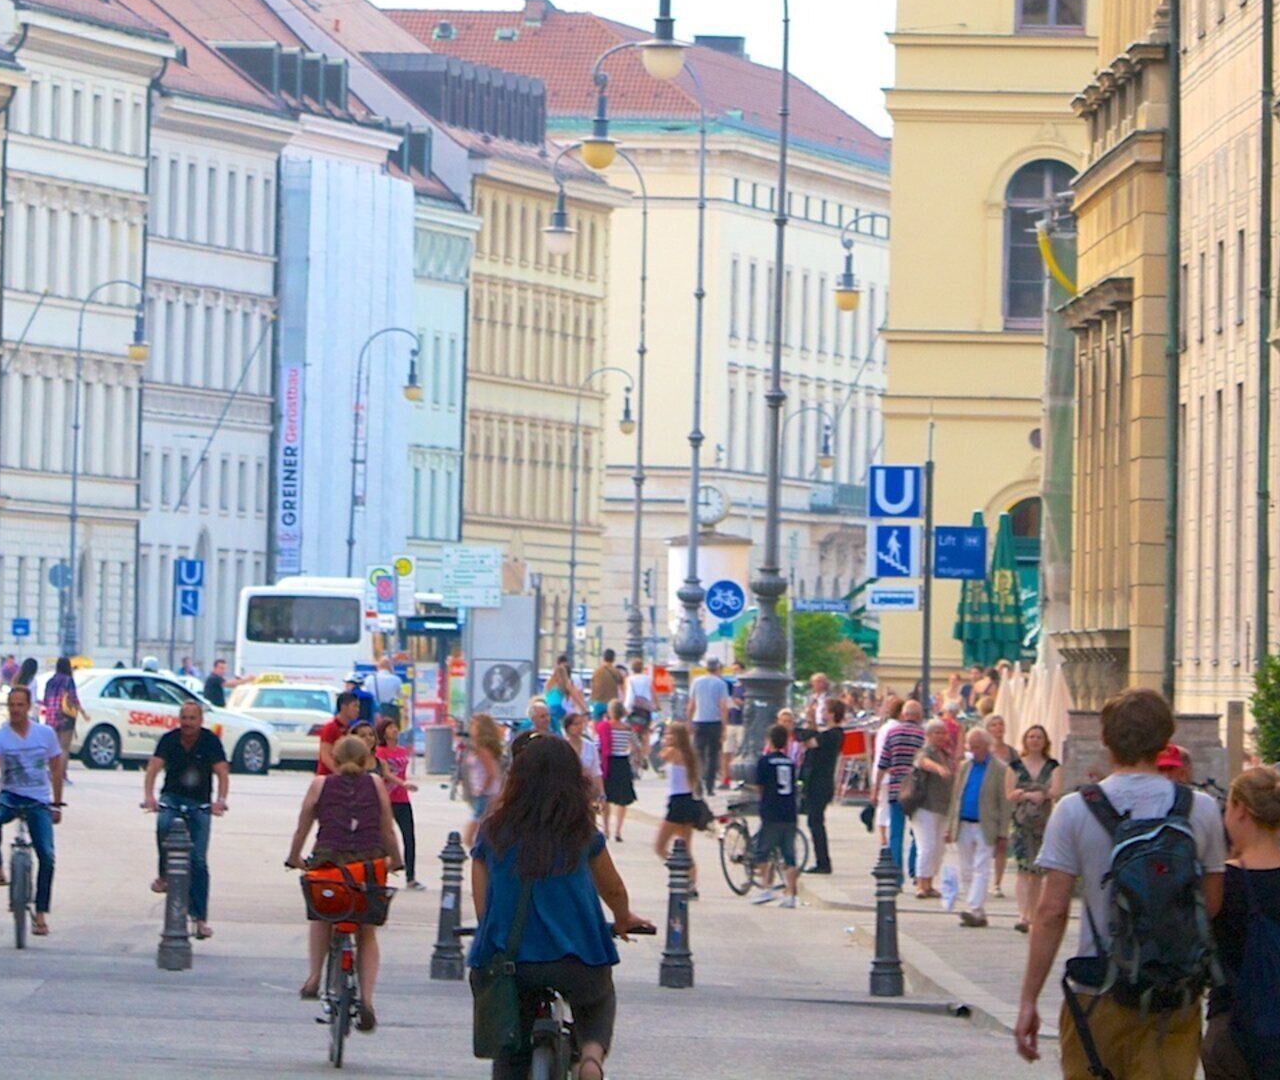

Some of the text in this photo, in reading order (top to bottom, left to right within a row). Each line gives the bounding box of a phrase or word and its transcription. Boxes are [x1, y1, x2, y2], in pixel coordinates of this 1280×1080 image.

[281, 445, 299, 527] GREINER
[875, 468, 914, 515] U
[938, 535, 956, 547] Lift
[180, 561, 201, 584] U
[775, 764, 792, 795] 9
